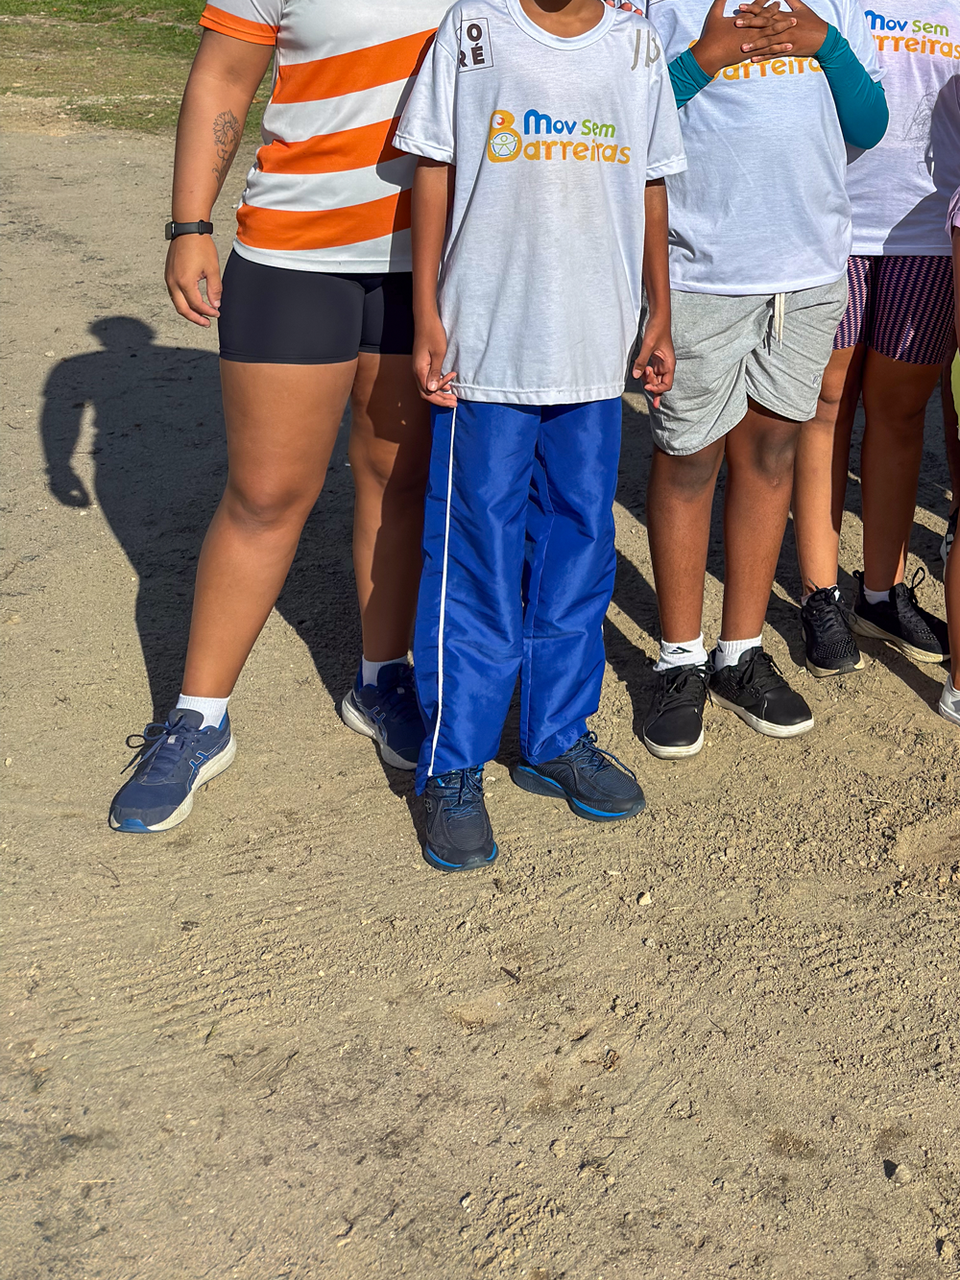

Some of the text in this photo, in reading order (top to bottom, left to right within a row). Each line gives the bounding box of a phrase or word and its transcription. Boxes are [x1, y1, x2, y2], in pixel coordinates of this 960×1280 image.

[912, 20, 949, 37] Sem
[523, 109, 616, 138] Mov Sem
